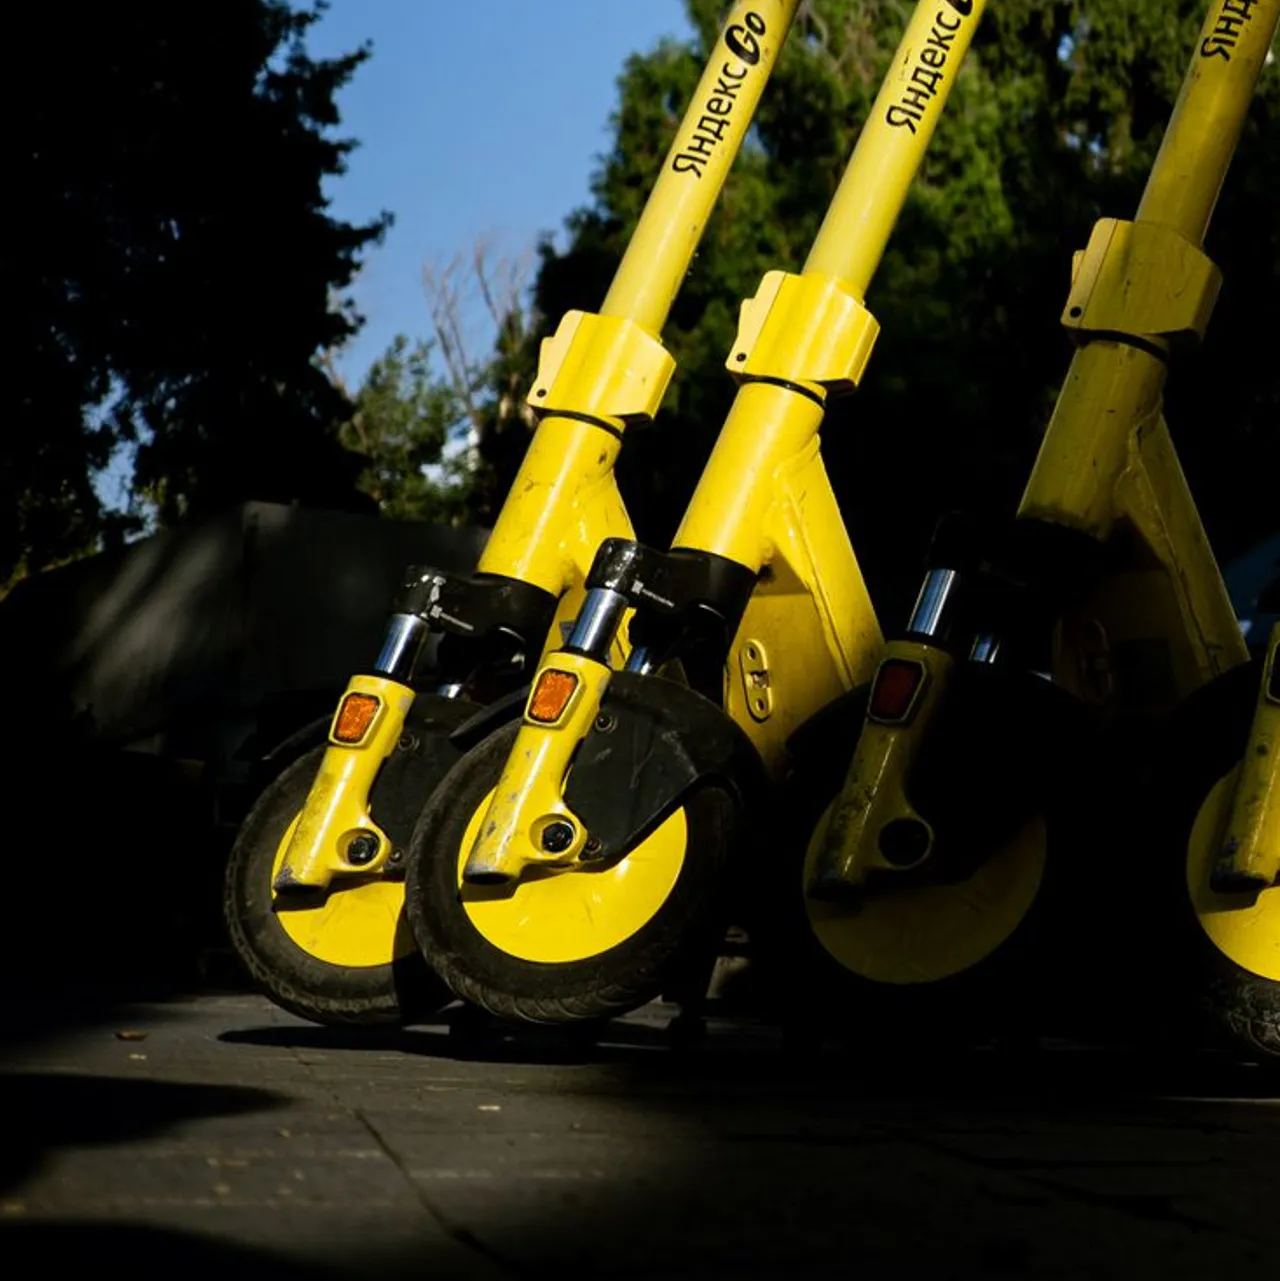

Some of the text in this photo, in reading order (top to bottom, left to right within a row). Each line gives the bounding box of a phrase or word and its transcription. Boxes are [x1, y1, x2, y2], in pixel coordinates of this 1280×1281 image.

[672, 12, 766, 178] Яндекс Go
[886, 10, 961, 134] Яндекс
